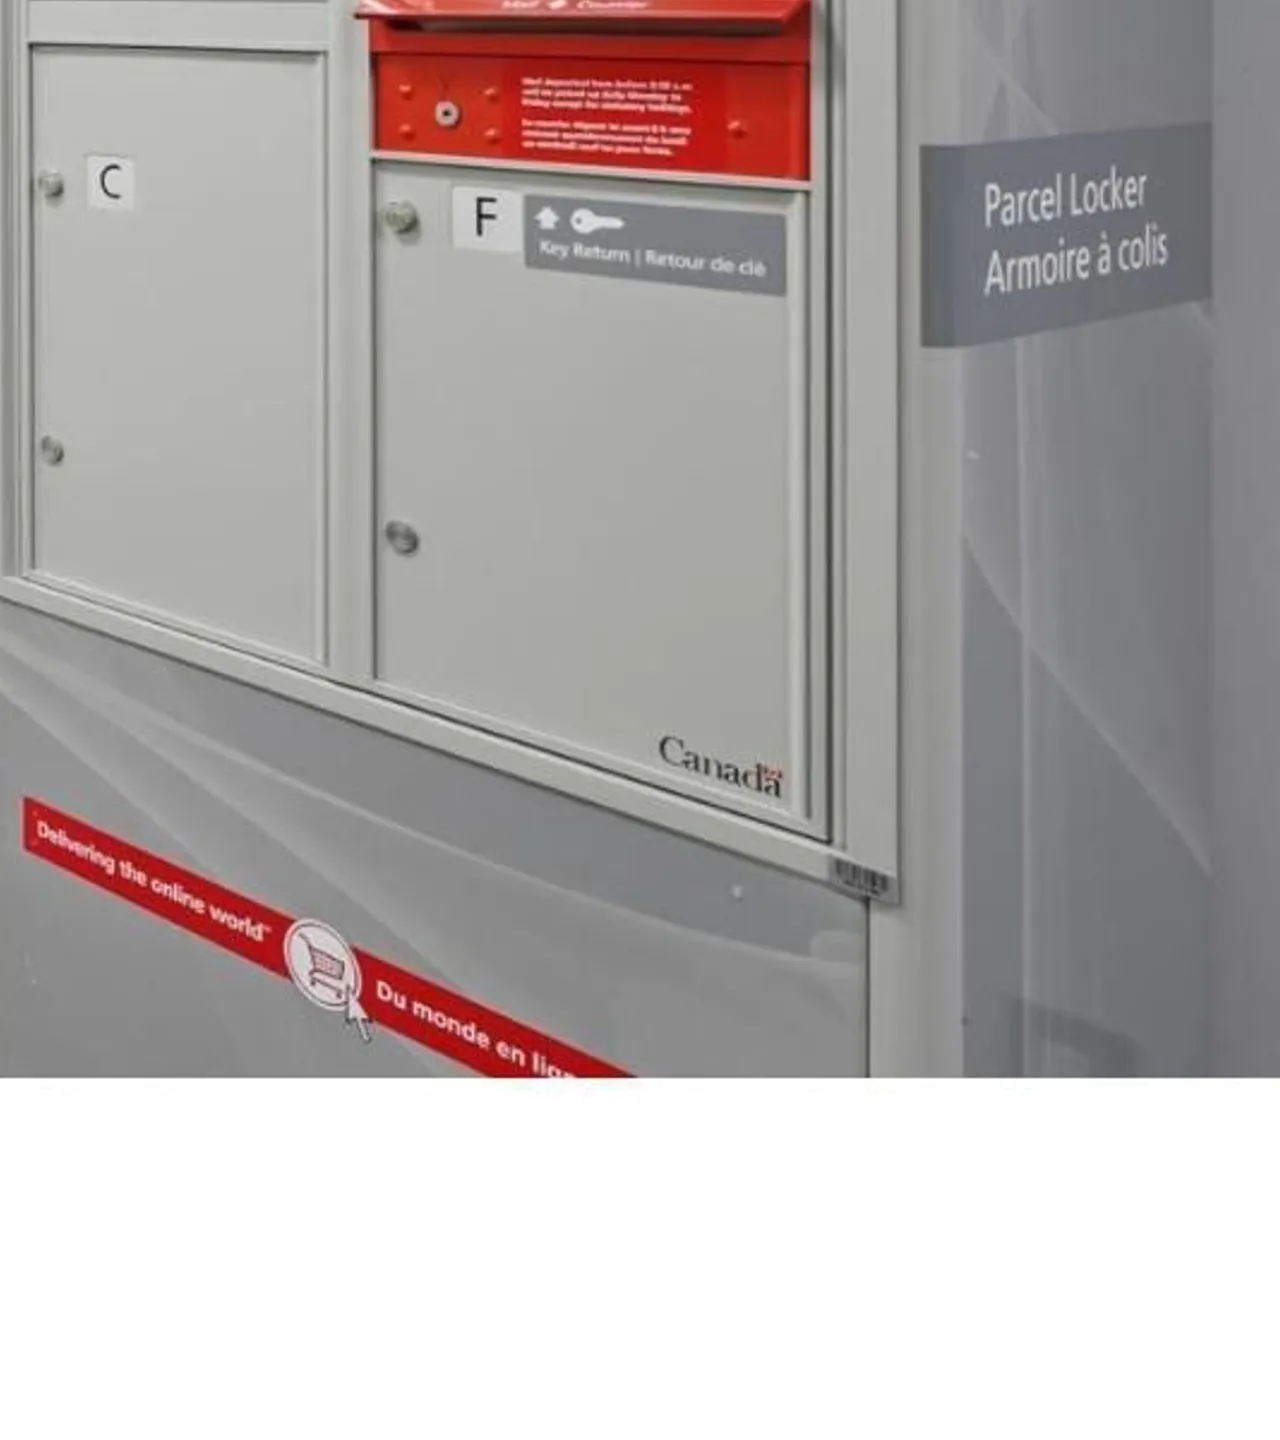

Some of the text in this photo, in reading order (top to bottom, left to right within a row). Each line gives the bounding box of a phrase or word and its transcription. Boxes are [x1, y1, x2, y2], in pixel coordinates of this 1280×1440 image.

[99, 163, 122, 200] C
[984, 164, 1148, 228] Parcel Locker
[476, 196, 498, 237] F
[540, 239, 570, 259] Key
[574, 241, 631, 263] Return
[645, 249, 705, 272] Retour
[710, 253, 735, 275] de
[739, 255, 767, 278] clé
[983, 221, 1169, 297] Armoire à colis
[658, 735, 782, 798] Canada
[36, 820, 116, 875] Delivering
[118, 859, 149, 887] the
[150, 878, 206, 914] online
[376, 979, 407, 1010] Du
[412, 999, 491, 1050] monde
[495, 1040, 526, 1067] en
